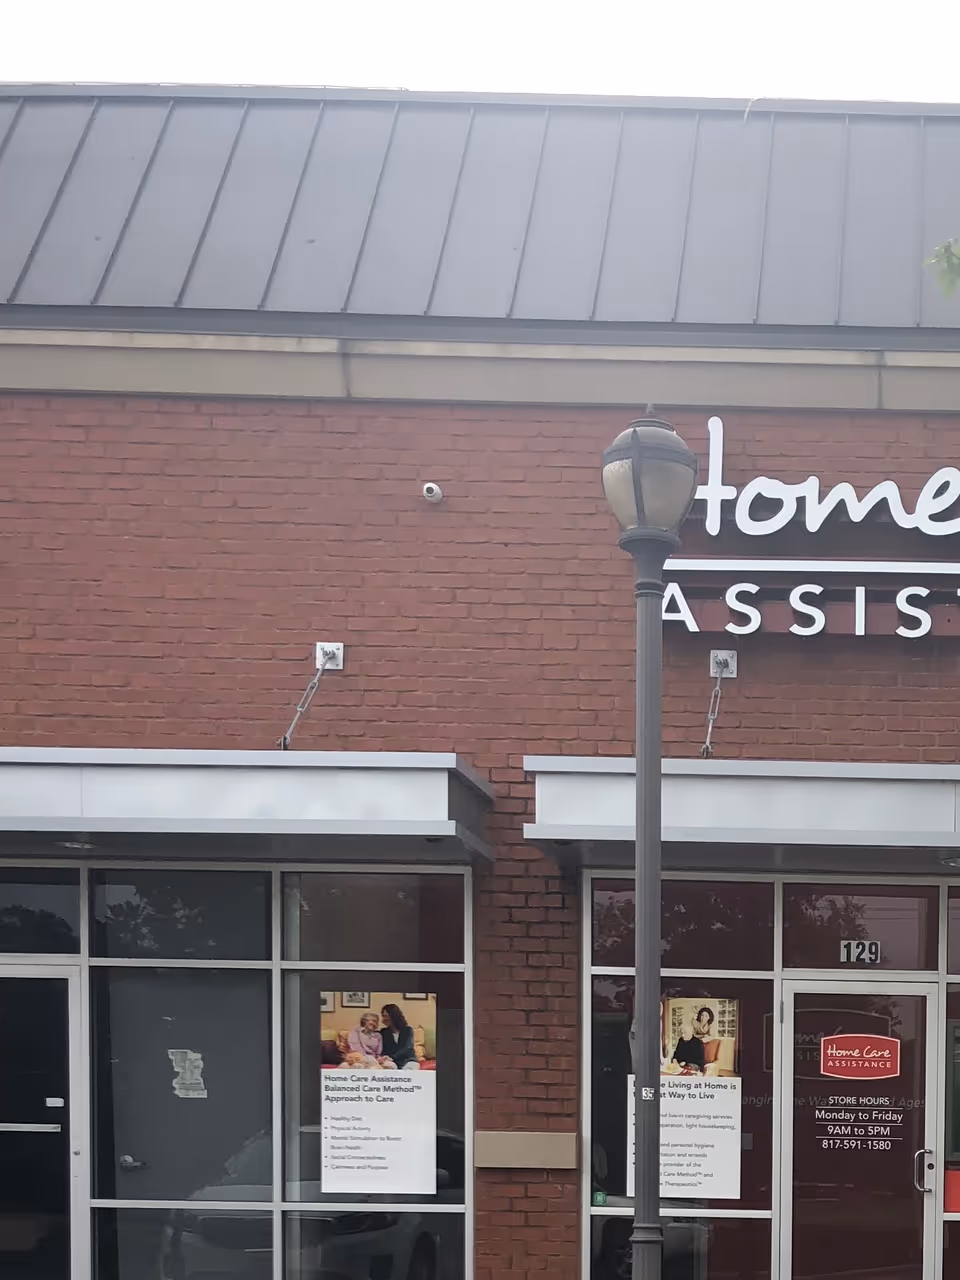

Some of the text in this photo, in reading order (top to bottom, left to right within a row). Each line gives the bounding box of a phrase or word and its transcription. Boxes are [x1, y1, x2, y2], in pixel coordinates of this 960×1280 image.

[843, 941, 879, 963] 129
[826, 1044, 860, 1056] Home
[862, 1045, 892, 1058] Care
[827, 1060, 892, 1068] ASSISTANCE
[668, 1081, 692, 1090] Living
[704, 1082, 728, 1090] Home
[643, 1088, 655, 1099] 35
[668, 1091, 686, 1100] Way
[324, 1094, 363, 1104] Approach
[828, 1096, 857, 1105] STORE
[860, 1096, 890, 1106] HOURS
[815, 1110, 903, 1123] Monday to Friday
[827, 1125, 890, 1136] 9AM to 5PM
[822, 1140, 891, 1150] 817-591-1580
